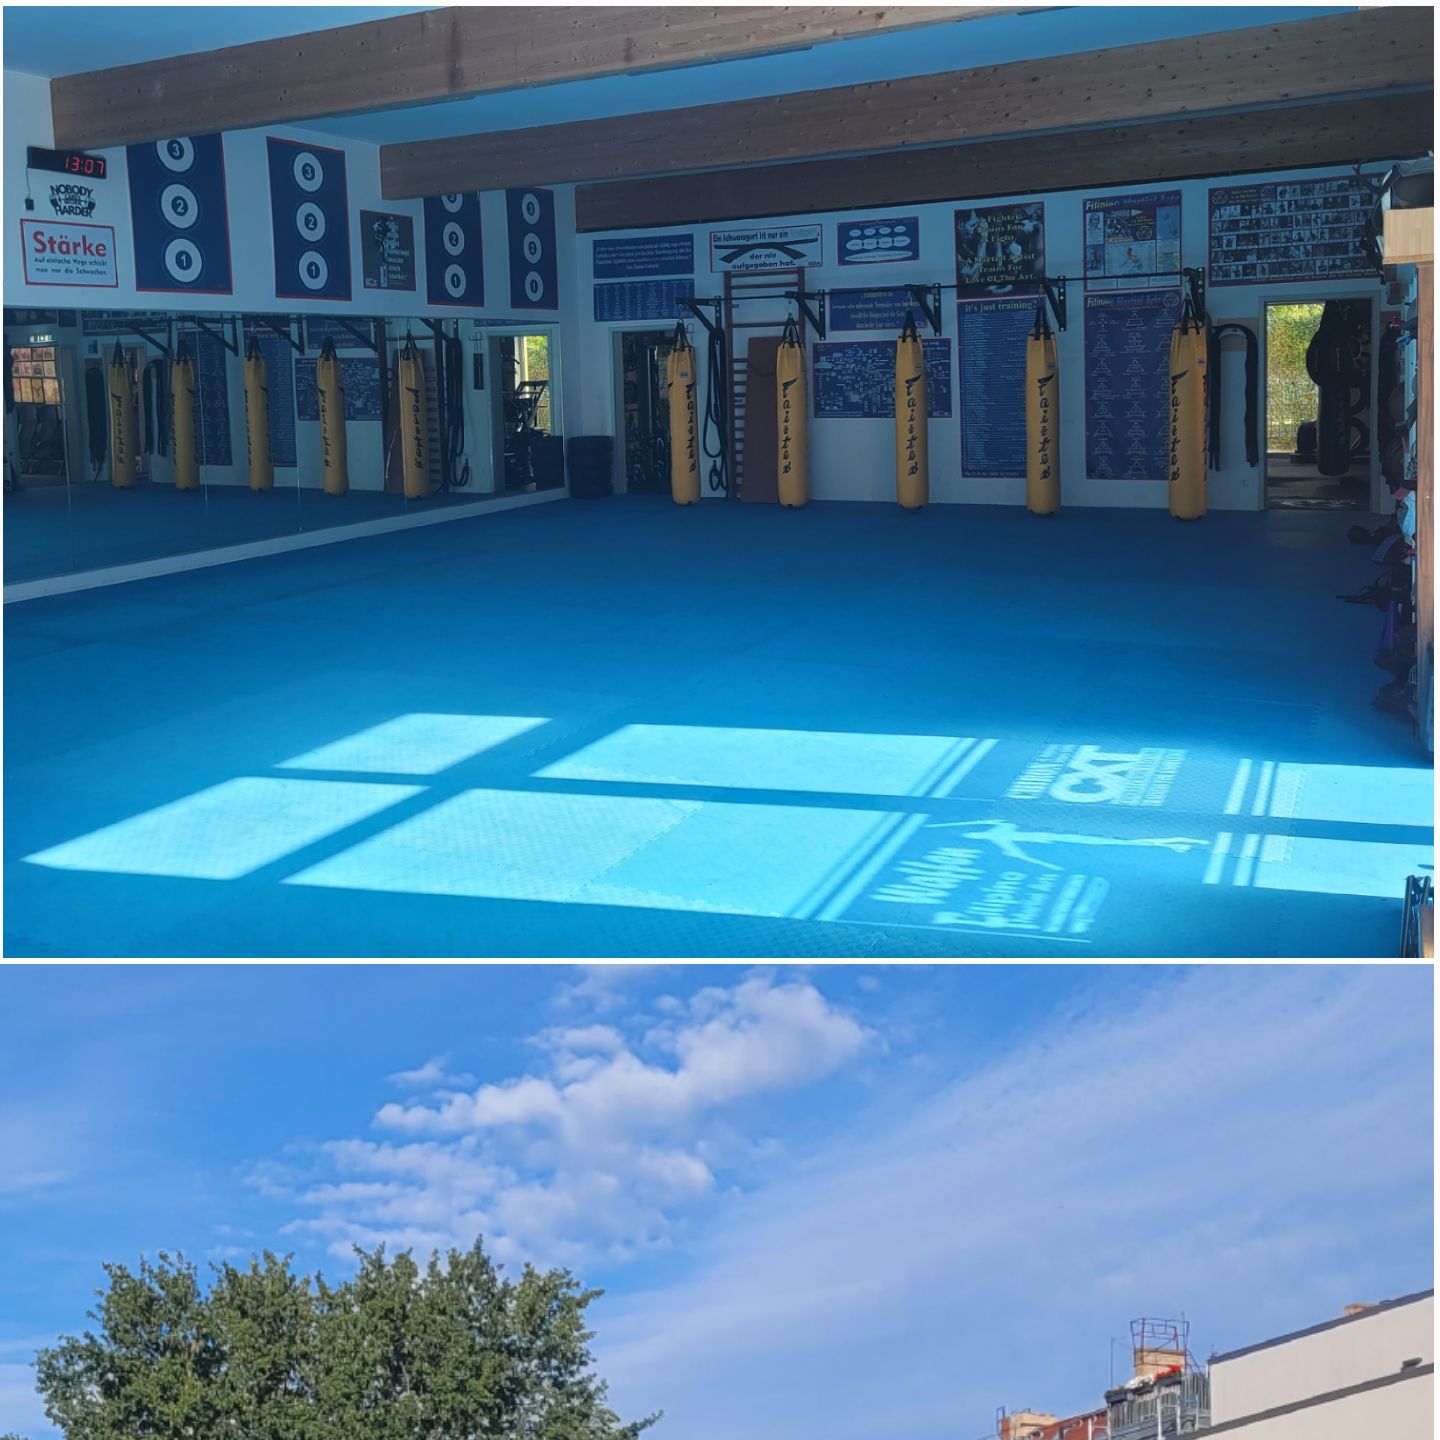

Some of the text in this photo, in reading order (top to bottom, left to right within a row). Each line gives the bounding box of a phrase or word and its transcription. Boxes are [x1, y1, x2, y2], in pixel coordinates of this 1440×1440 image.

[65, 157, 104, 175] 13:07
[49, 184, 94, 198] NOBODY
[55, 206, 93, 218] HARDER
[988, 214, 1019, 224] Fighter
[33, 231, 107, 257] Stärke
[713, 234, 722, 242] Ein
[731, 260, 779, 270] aufgegeben
[975, 255, 1006, 264] Martial
[965, 276, 985, 284] Love
[781, 377, 799, 474] Fairtex
[905, 373, 922, 476] Fairtex
[1037, 372, 1056, 480] Fairtex
[1170, 369, 1190, 482] Fairtex
